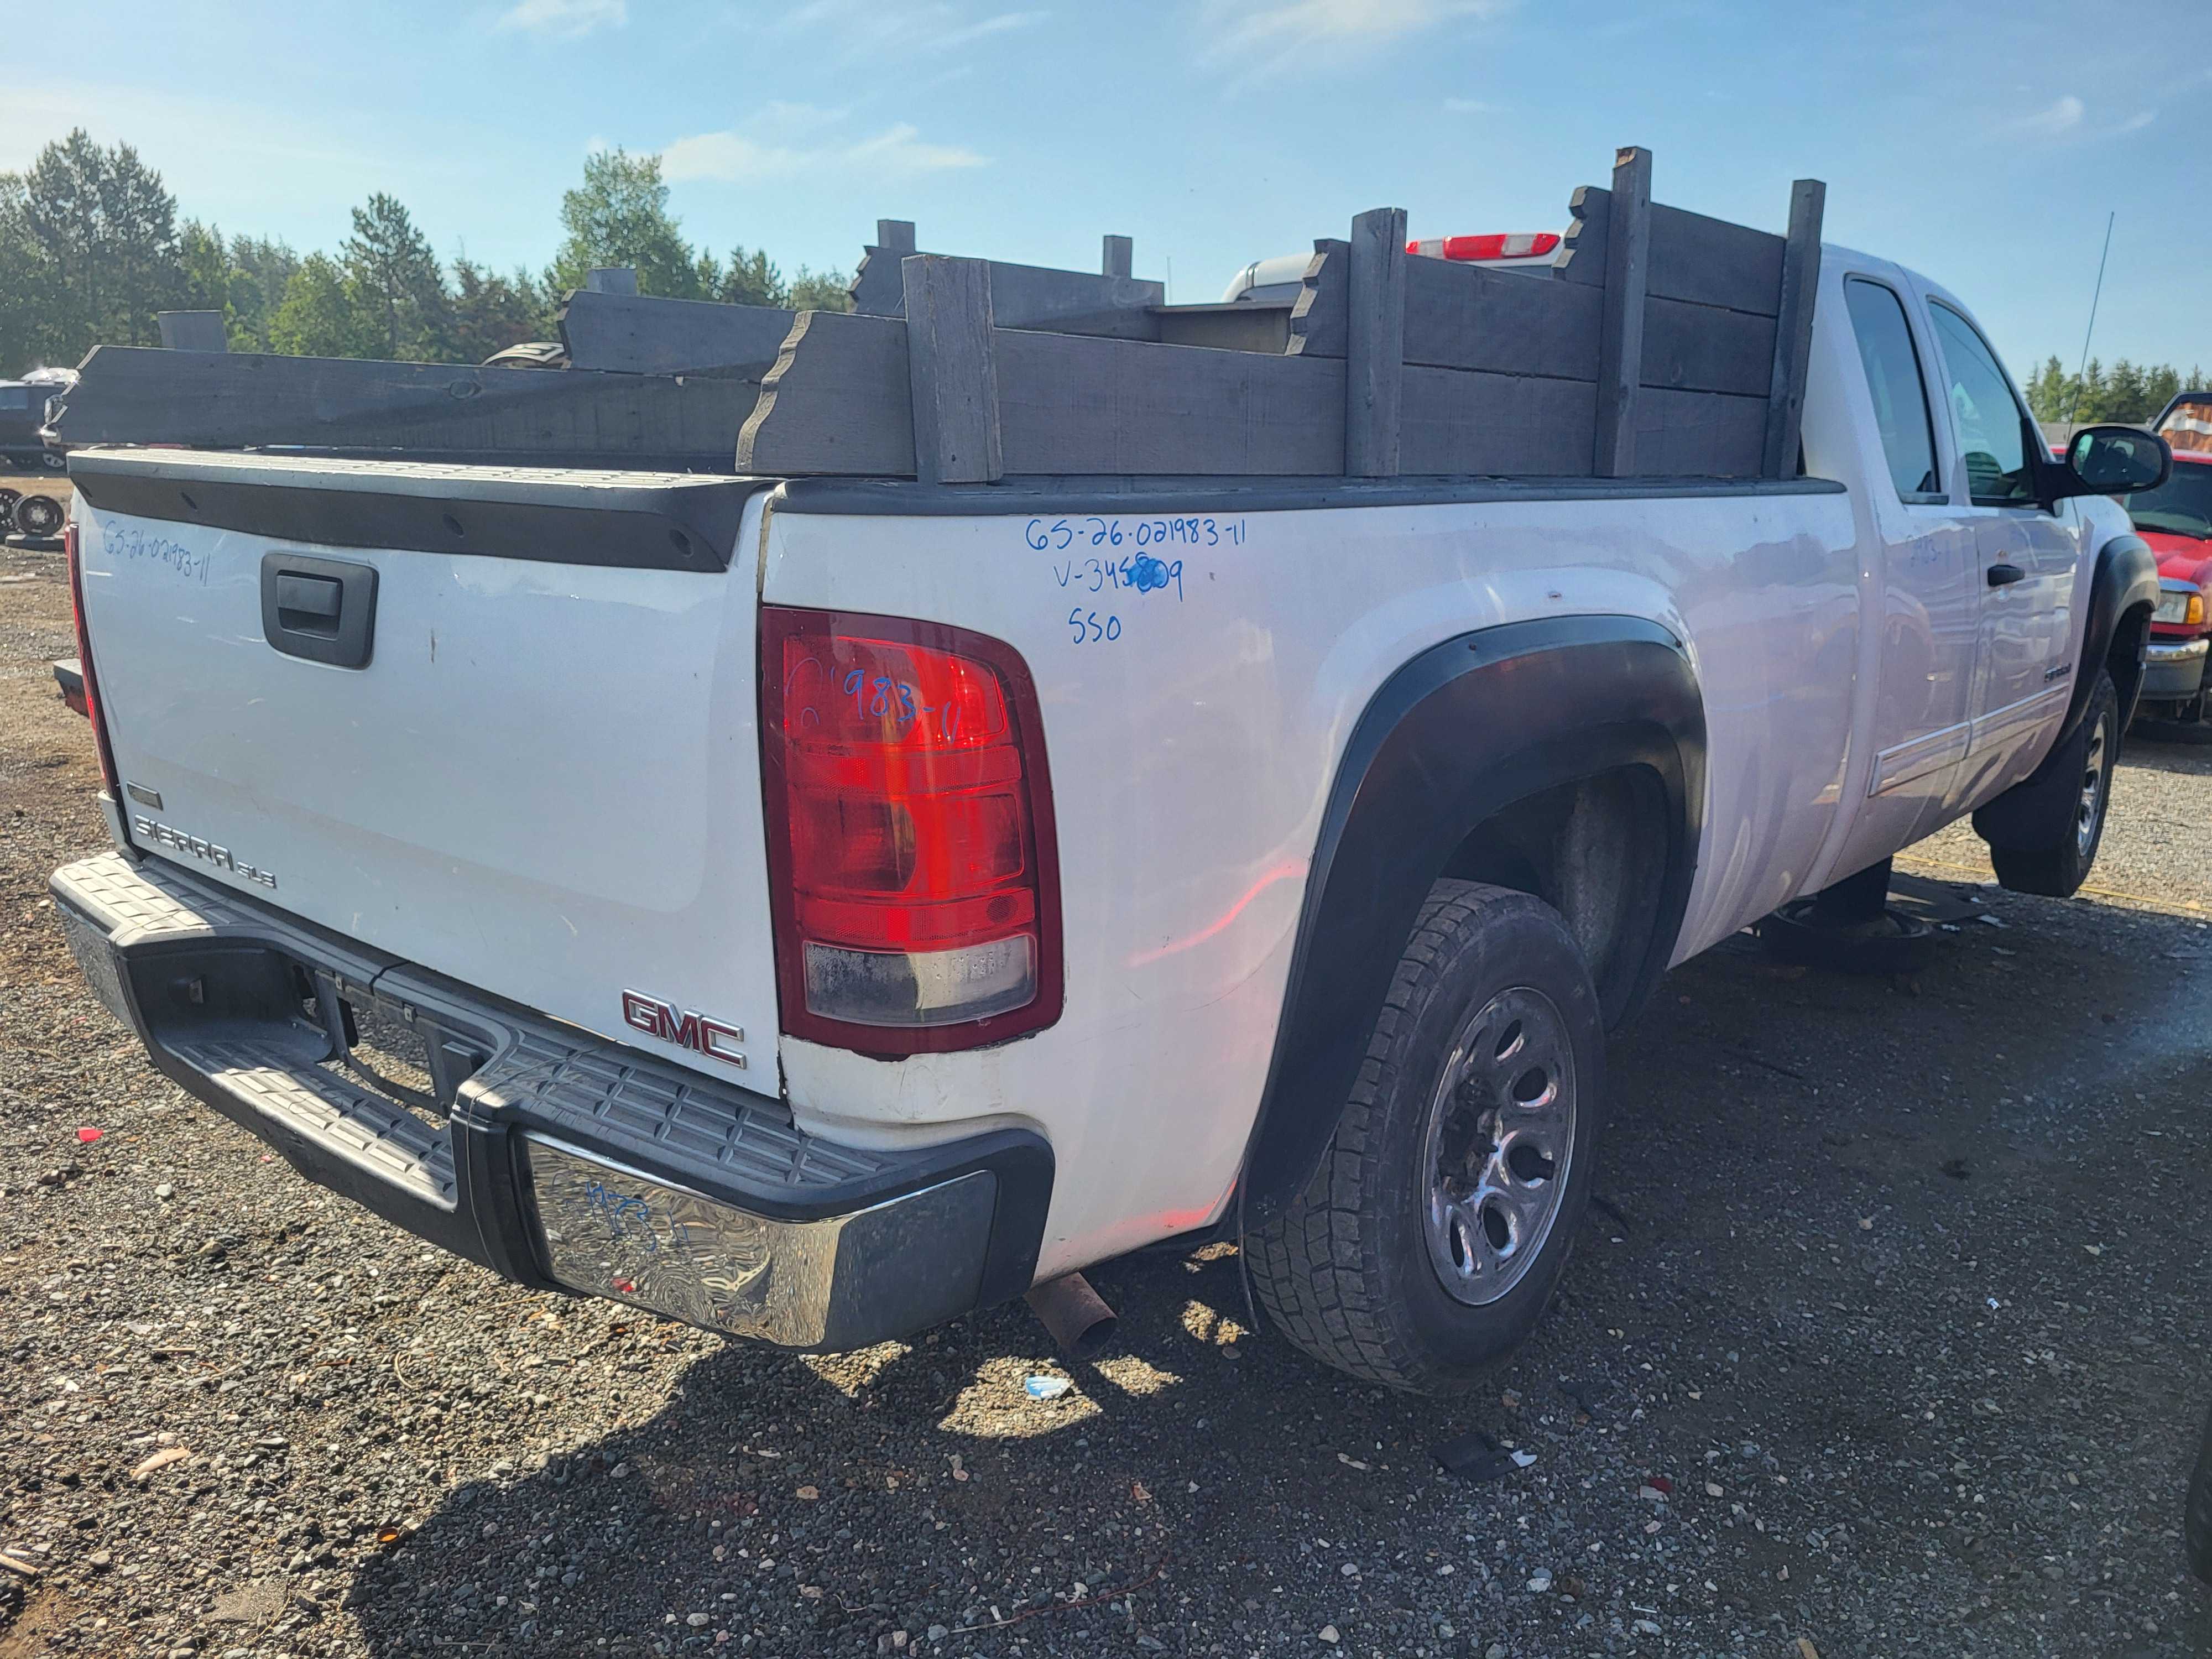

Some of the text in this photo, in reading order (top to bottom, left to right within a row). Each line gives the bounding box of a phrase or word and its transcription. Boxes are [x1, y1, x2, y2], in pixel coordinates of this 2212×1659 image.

[134, 813, 278, 889] SIERRA SLE
[622, 988, 747, 1070] GMC
